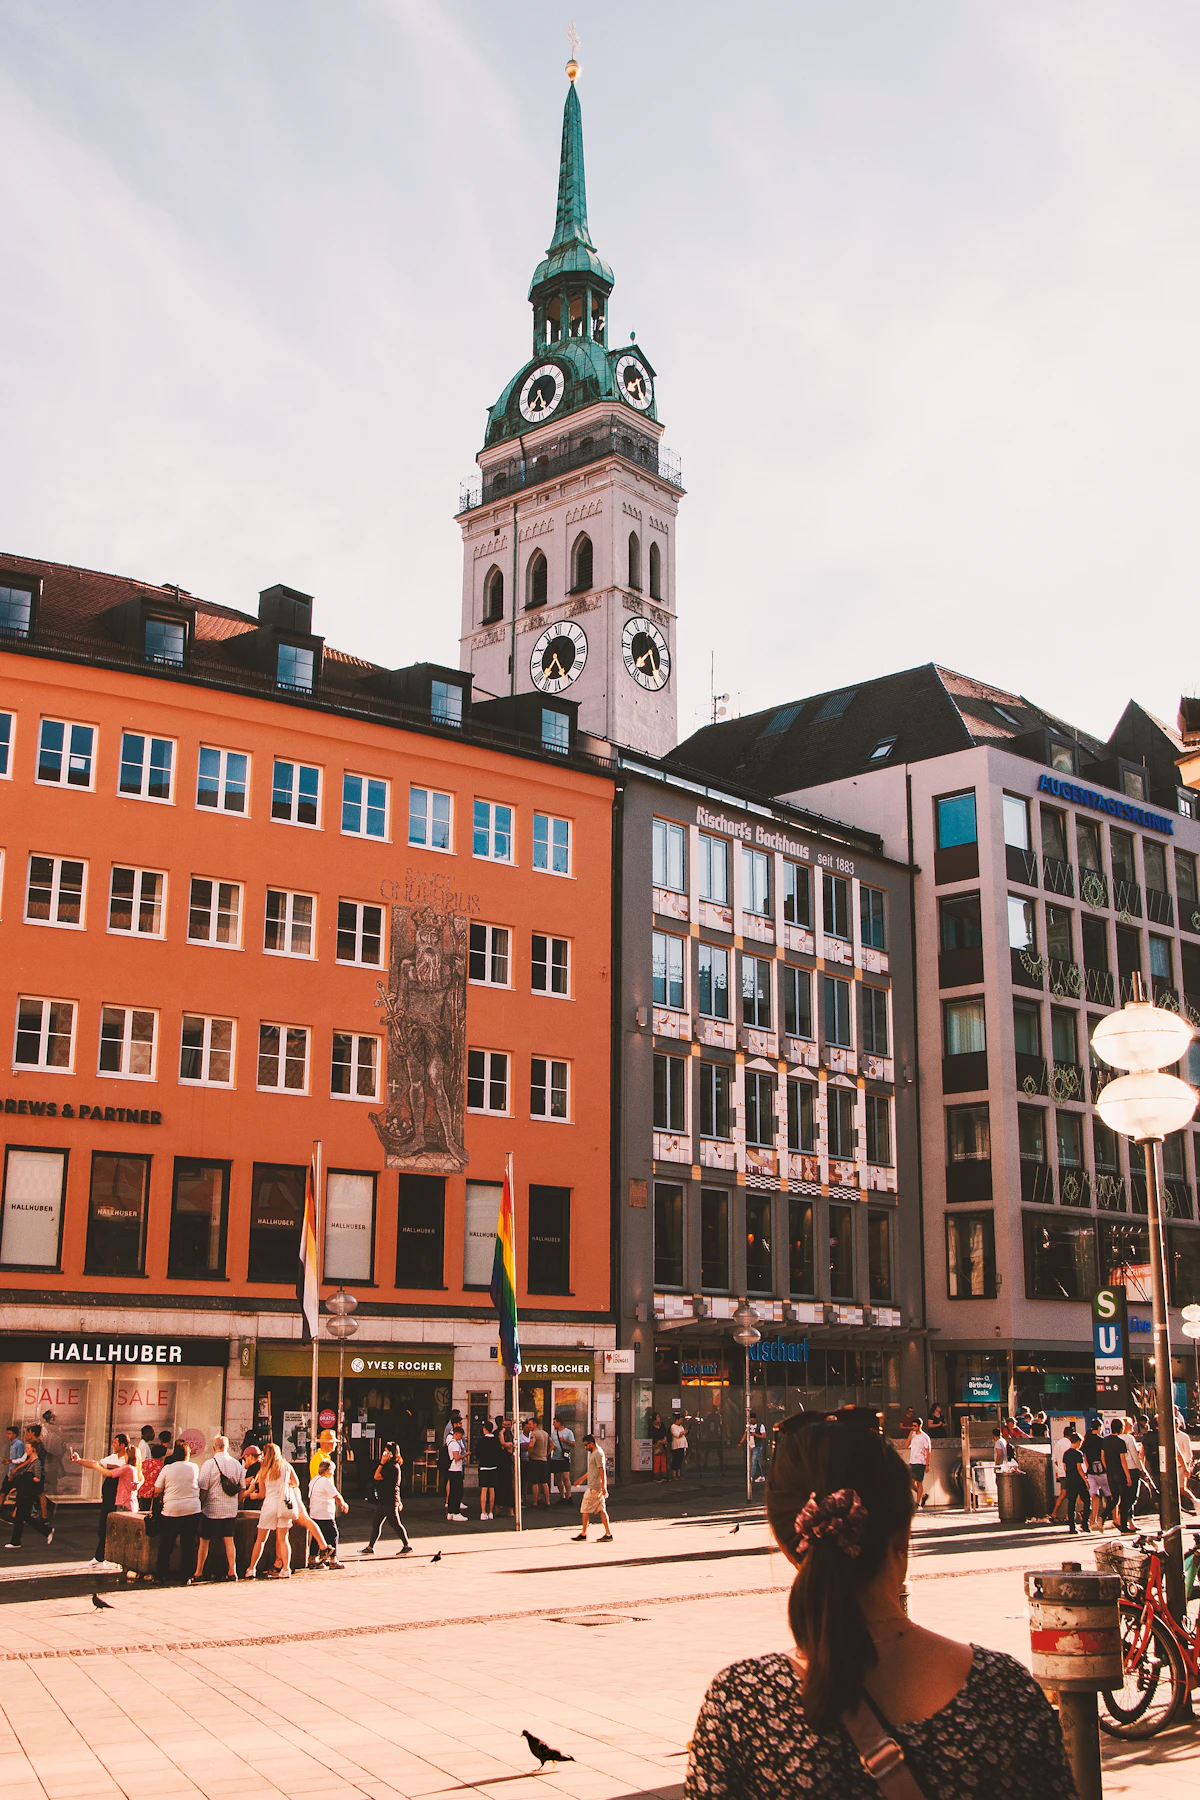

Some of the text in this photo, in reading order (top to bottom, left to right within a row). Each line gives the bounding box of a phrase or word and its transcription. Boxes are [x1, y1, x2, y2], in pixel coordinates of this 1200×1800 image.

[1038, 774, 1174, 835] AUGENTAGESKLINIK
[817, 852, 833, 868] seit
[835, 857, 855, 875] 1883
[61, 1103, 75, 1118] &
[78, 1104, 162, 1125] PARTNER
[11, 1204, 53, 1212] HALLHUBER
[97, 1209, 138, 1217] HALLHUBER
[257, 1218, 294, 1226] HALLHUBER
[331, 1222, 366, 1230] HALLHUBER
[1097, 1290, 1116, 1318] S
[1128, 1315, 1152, 1333] Live
[1098, 1326, 1117, 1354] U
[50, 1342, 182, 1363] HALLHUBER
[367, 1361, 442, 1371] YVES ROCHER
[524, 1364, 590, 1373] YVES ROCHER
[968, 1382, 993, 1390] Birthday
[25, 1388, 79, 1405] SALE
[117, 1389, 168, 1406] SALE
